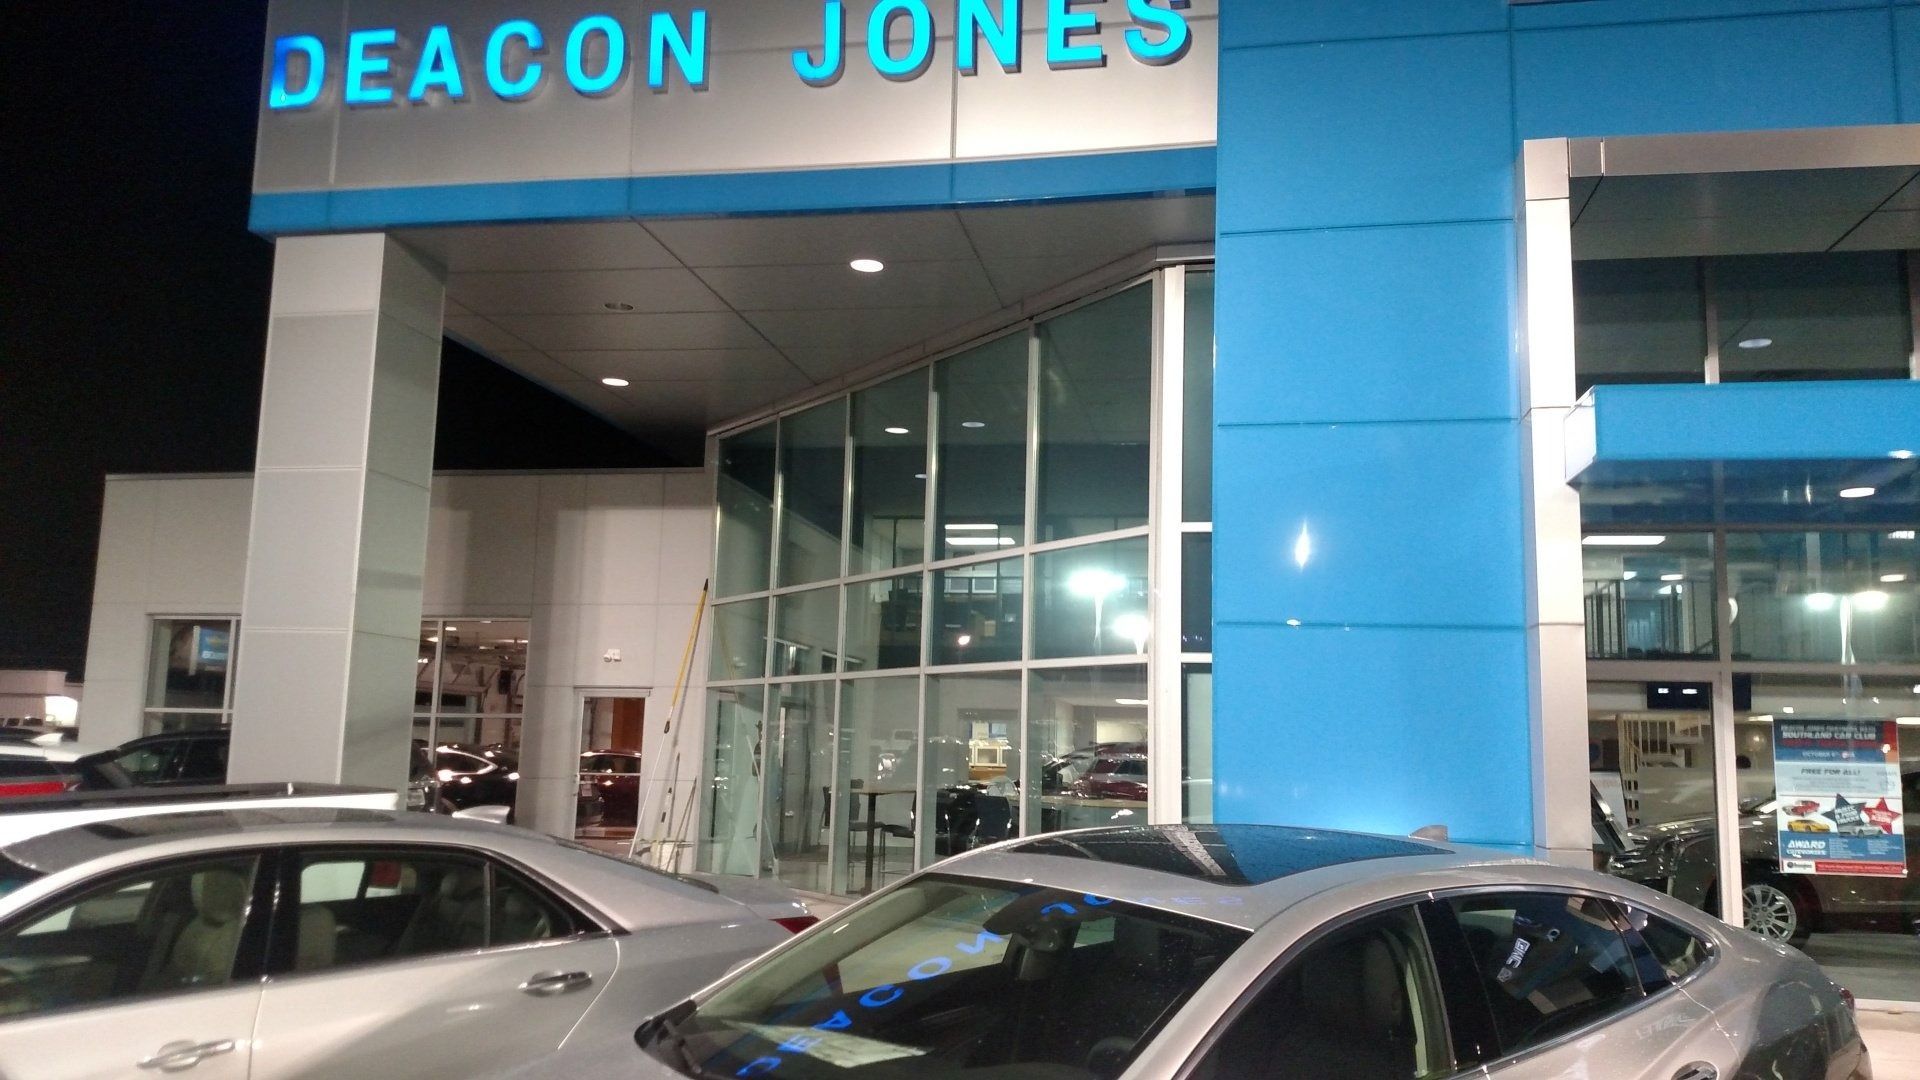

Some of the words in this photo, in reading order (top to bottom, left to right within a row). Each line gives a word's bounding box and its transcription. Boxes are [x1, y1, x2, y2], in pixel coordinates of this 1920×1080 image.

[269, 9, 709, 110] DEACON
[791, 0, 1194, 87] JONES
[1787, 840, 1826, 849] AWARD
